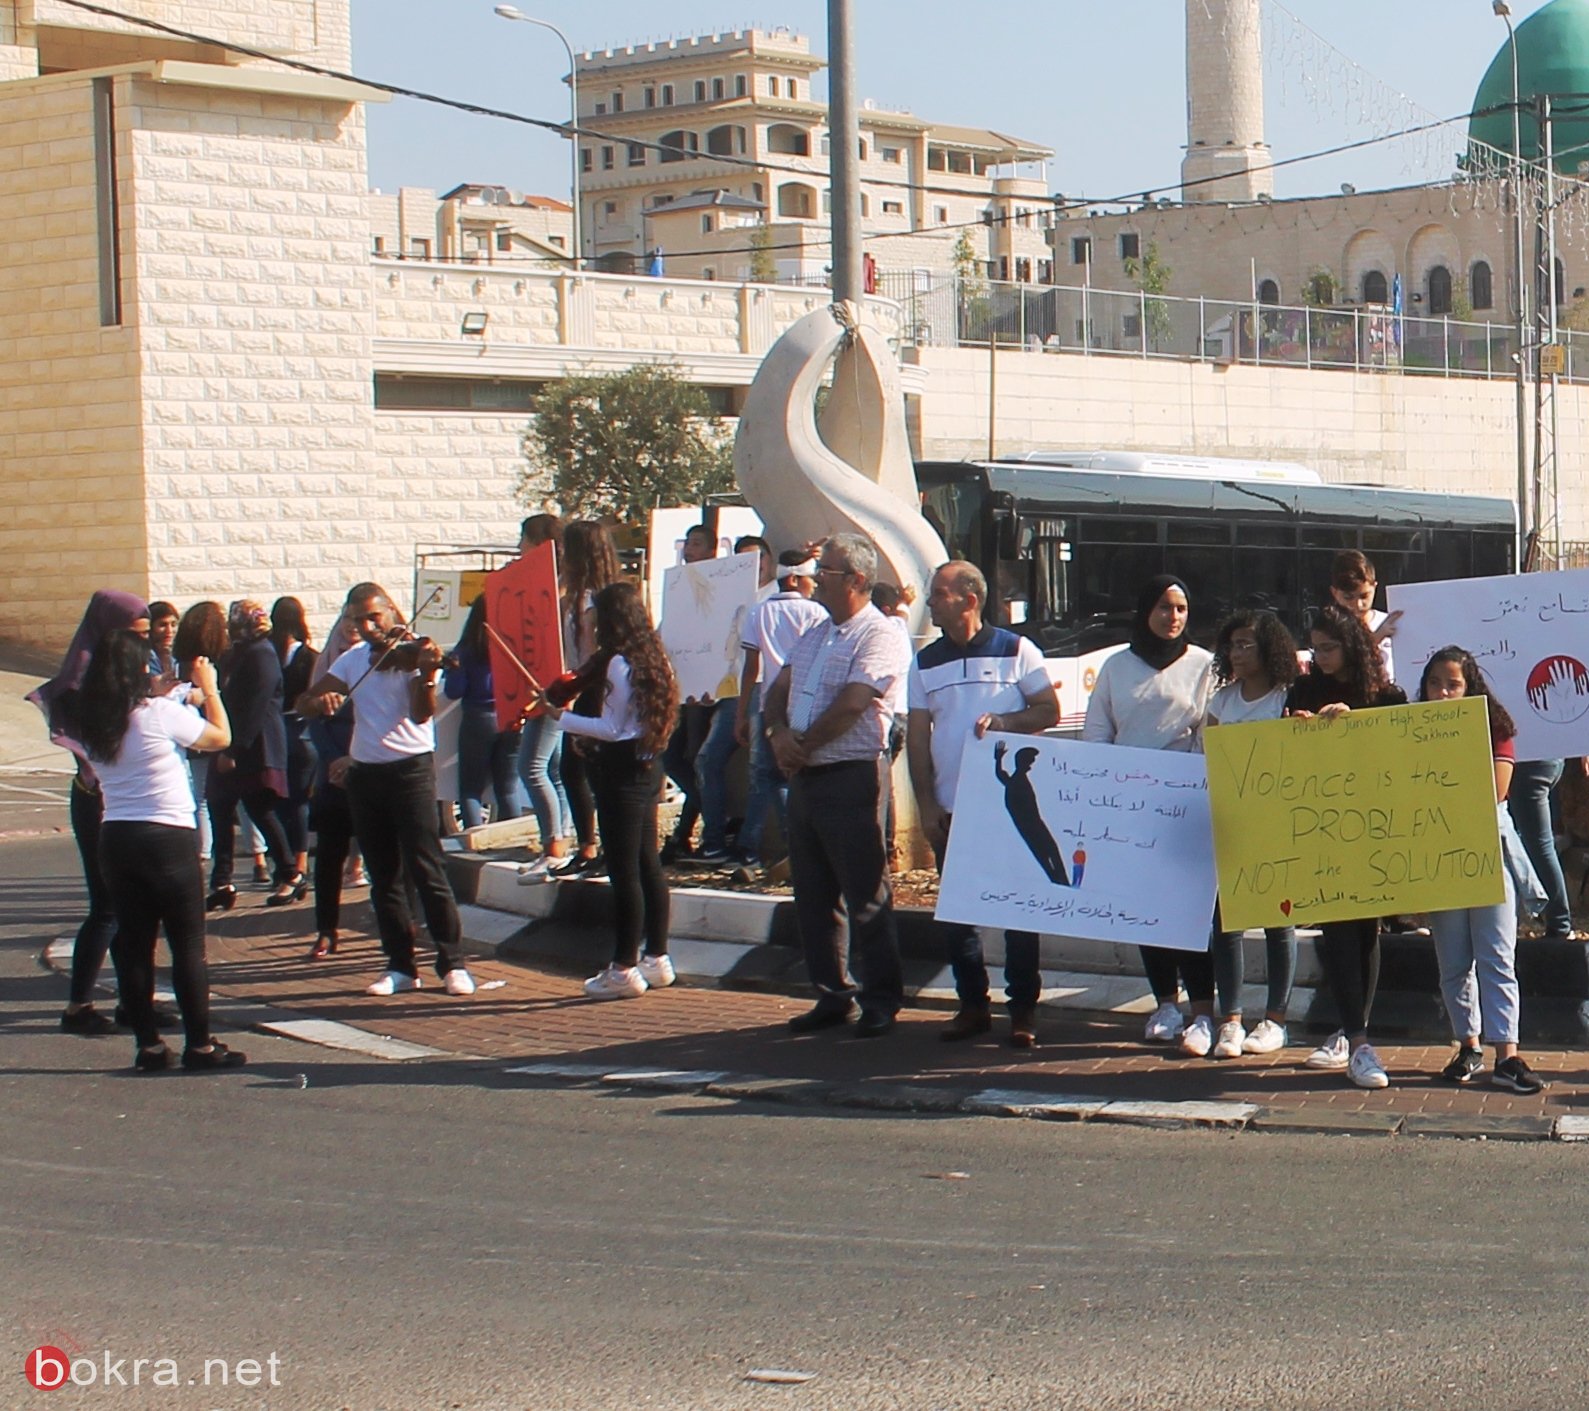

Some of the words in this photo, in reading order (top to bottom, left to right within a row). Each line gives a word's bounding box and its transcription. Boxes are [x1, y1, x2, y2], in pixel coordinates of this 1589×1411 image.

[1339, 715, 1381, 737] Junior
[1218, 738, 1356, 800] Violence
[1377, 769, 1393, 790] is
[1411, 761, 1459, 788] the
[1129, 800, 1144, 811] لا
[1290, 806, 1451, 845] PROBLEM
[1232, 857, 1300, 896] NOT
[1314, 857, 1342, 879] the
[1368, 848, 1497, 887] SOLUTION
